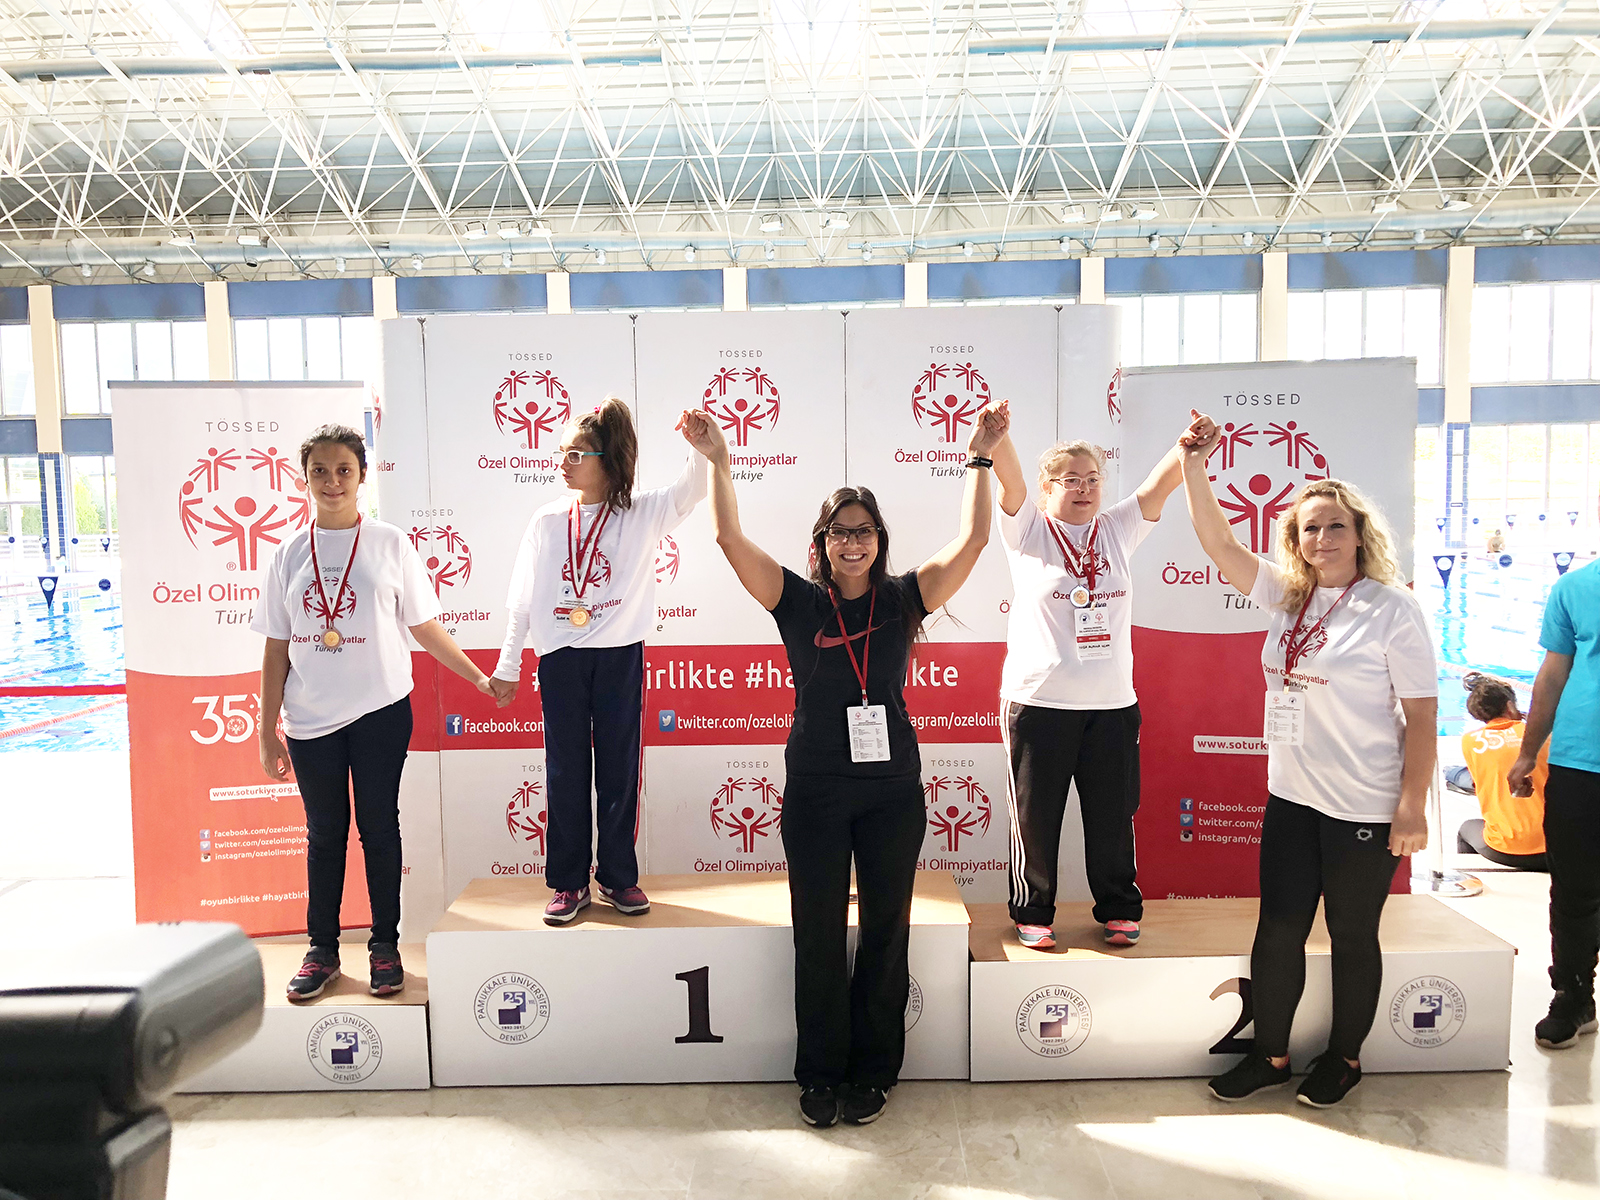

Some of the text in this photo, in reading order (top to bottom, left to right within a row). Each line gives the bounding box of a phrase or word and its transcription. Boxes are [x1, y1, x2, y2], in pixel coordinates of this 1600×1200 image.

[1223, 391, 1301, 407] TÖSSED
[205, 417, 279, 433] TÖSSED
[477, 454, 506, 469] Özel
[894, 448, 923, 463] Özel
[513, 473, 556, 486] Türkiye
[930, 466, 967, 479] Türkiy
[1161, 562, 1210, 585] Özel
[152, 581, 202, 604] Özel
[1470, 729, 1505, 754] 35
[212, 784, 300, 798] www.soturkiye.org.t
[214, 837, 309, 850] twitter.com/ozelolimpiya
[215, 847, 305, 860] instagram/ozelolimpiyat
[491, 861, 519, 875] Özel
[694, 858, 722, 872] Özel
[929, 858, 1009, 874] Olimpiyatlar
[200, 894, 261, 907] #oyunbirlikte
[477, 976, 508, 1020] PAMUKKALE
[504, 992, 524, 1006] 25
[675, 965, 724, 1044] 1
[1019, 989, 1051, 1033] PAMUKKALE
[1047, 1005, 1066, 1018] 25
[310, 1016, 340, 1060] PAMUKKALE
[336, 1032, 356, 1046] 25
